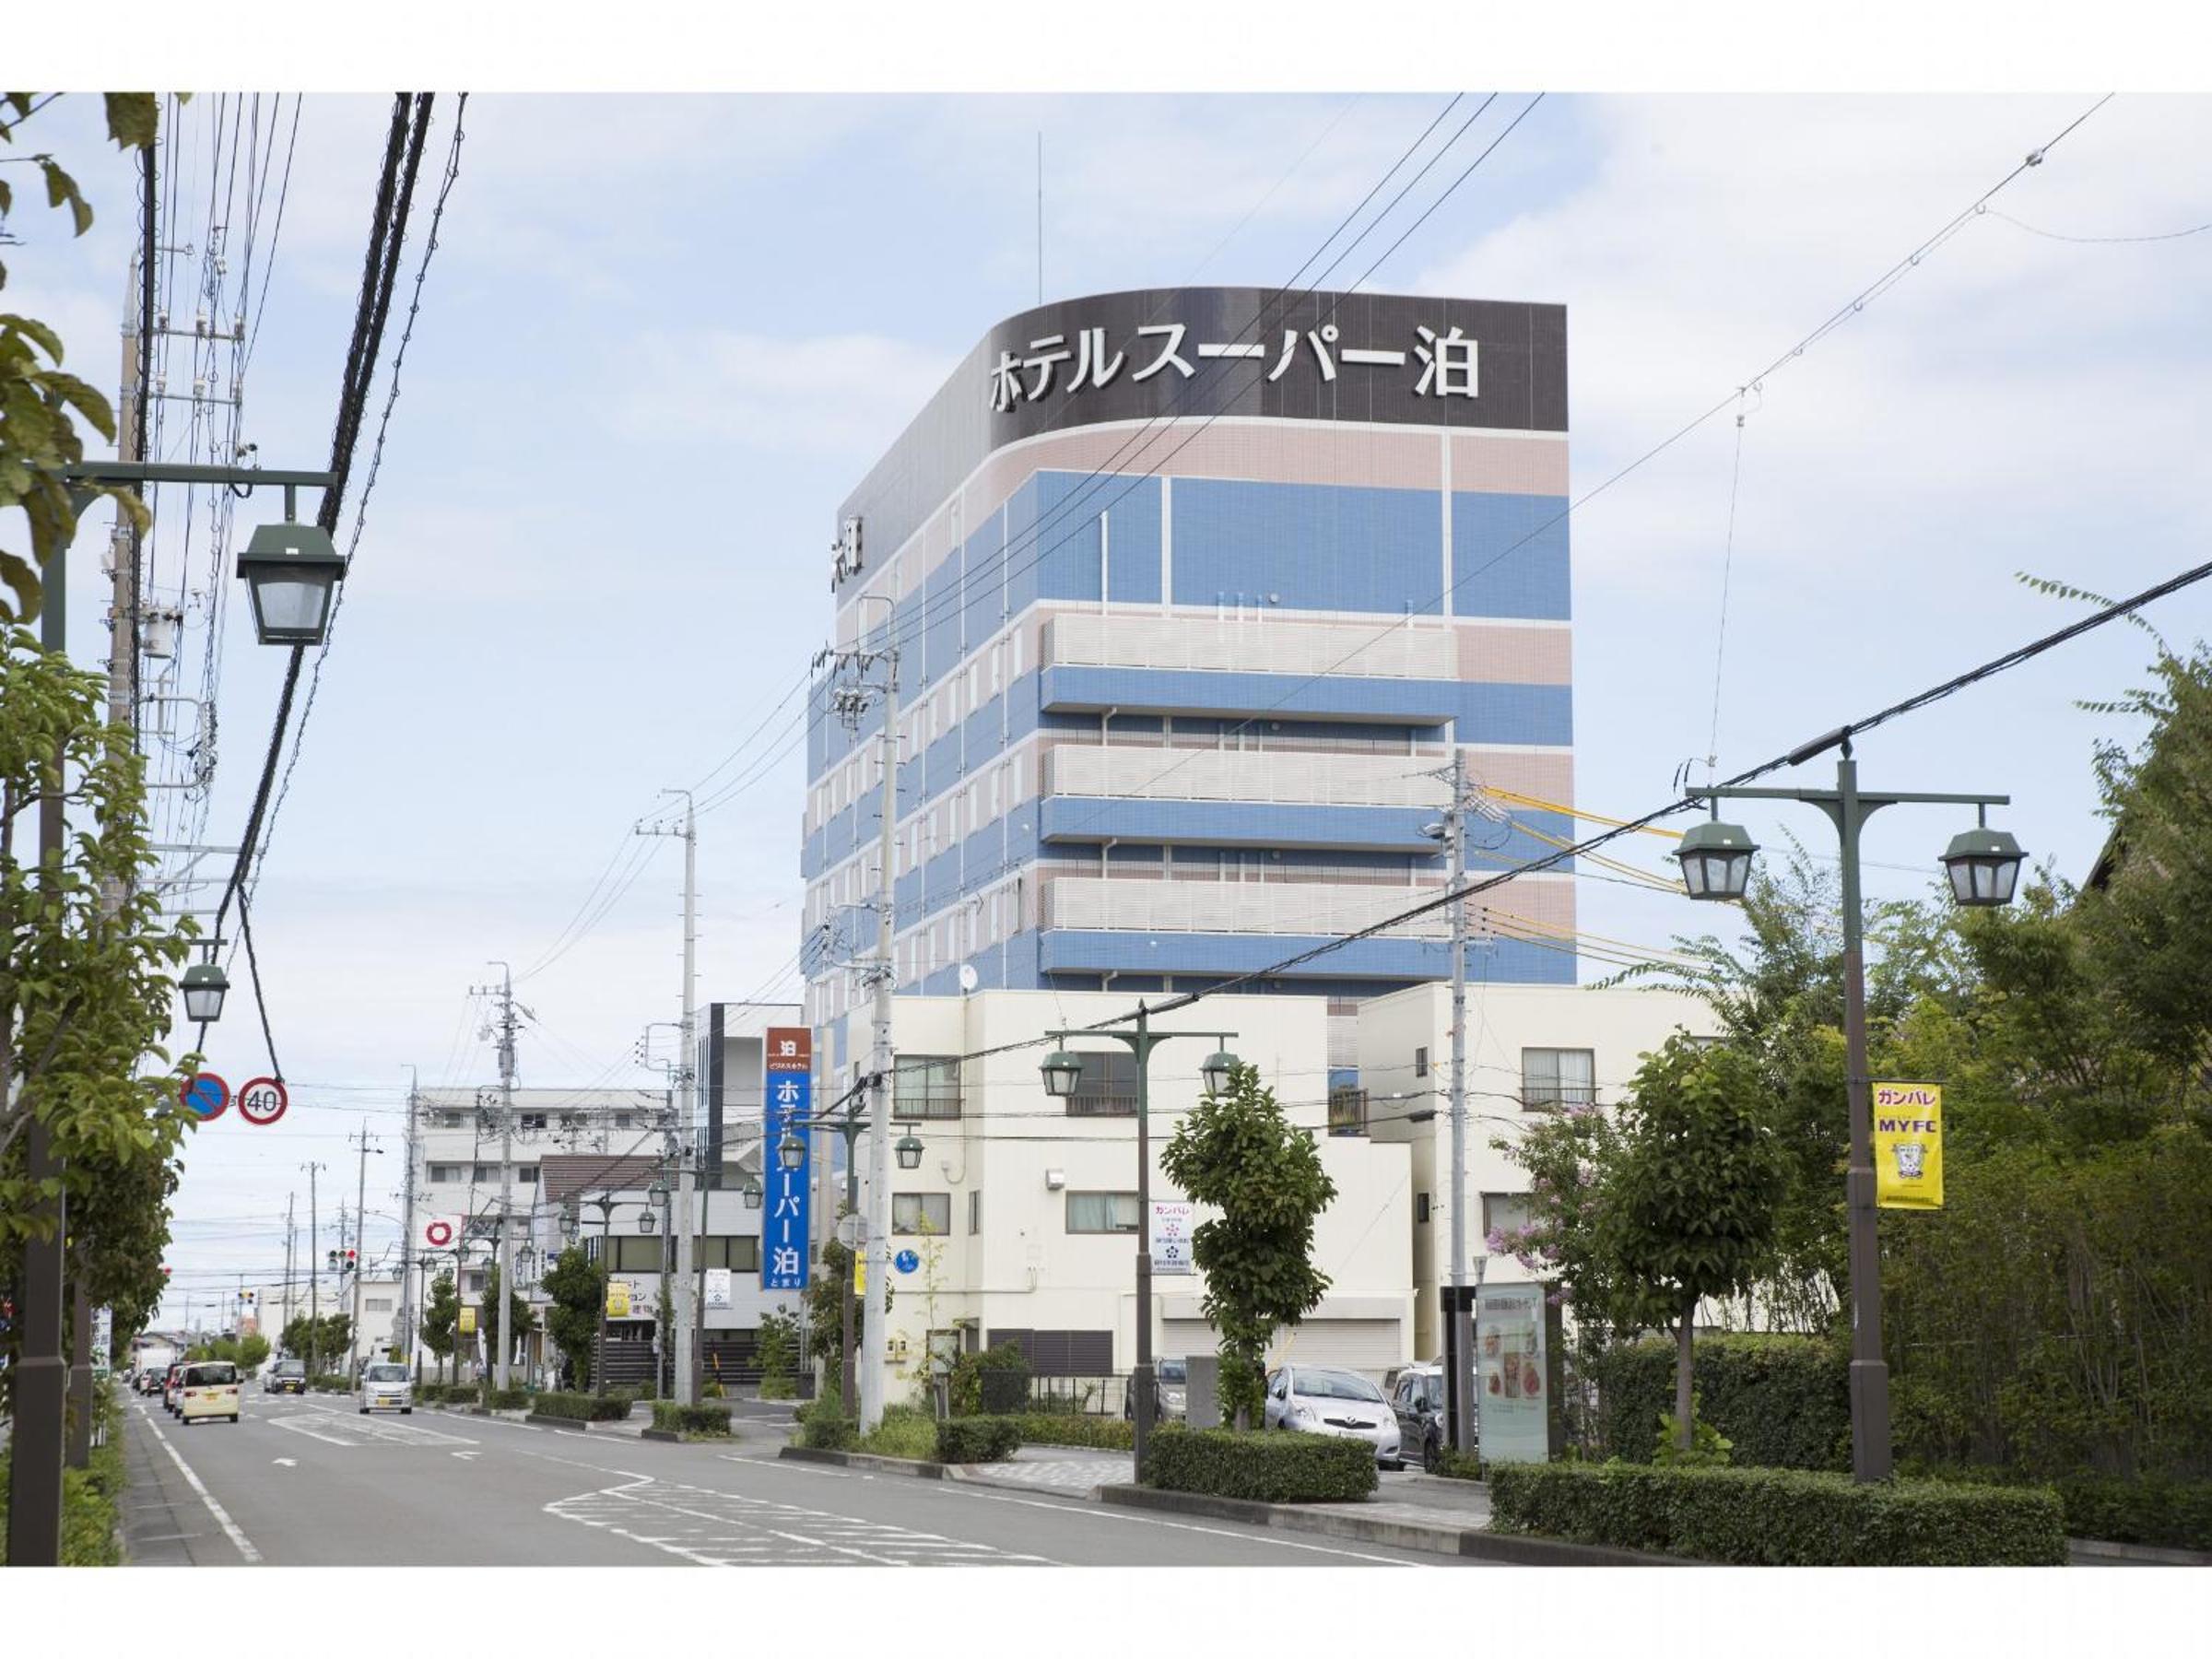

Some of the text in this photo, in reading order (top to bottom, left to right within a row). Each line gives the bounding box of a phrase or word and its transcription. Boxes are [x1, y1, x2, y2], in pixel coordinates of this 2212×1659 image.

[989, 322, 1479, 412] ホテルスーパー泊
[247, 1090, 277, 1112] 40
[1878, 1089, 1936, 1106] ガンバレ
[1879, 1119, 1937, 1134] MYFC
[773, 1080, 800, 1276] ホテーパー泊
